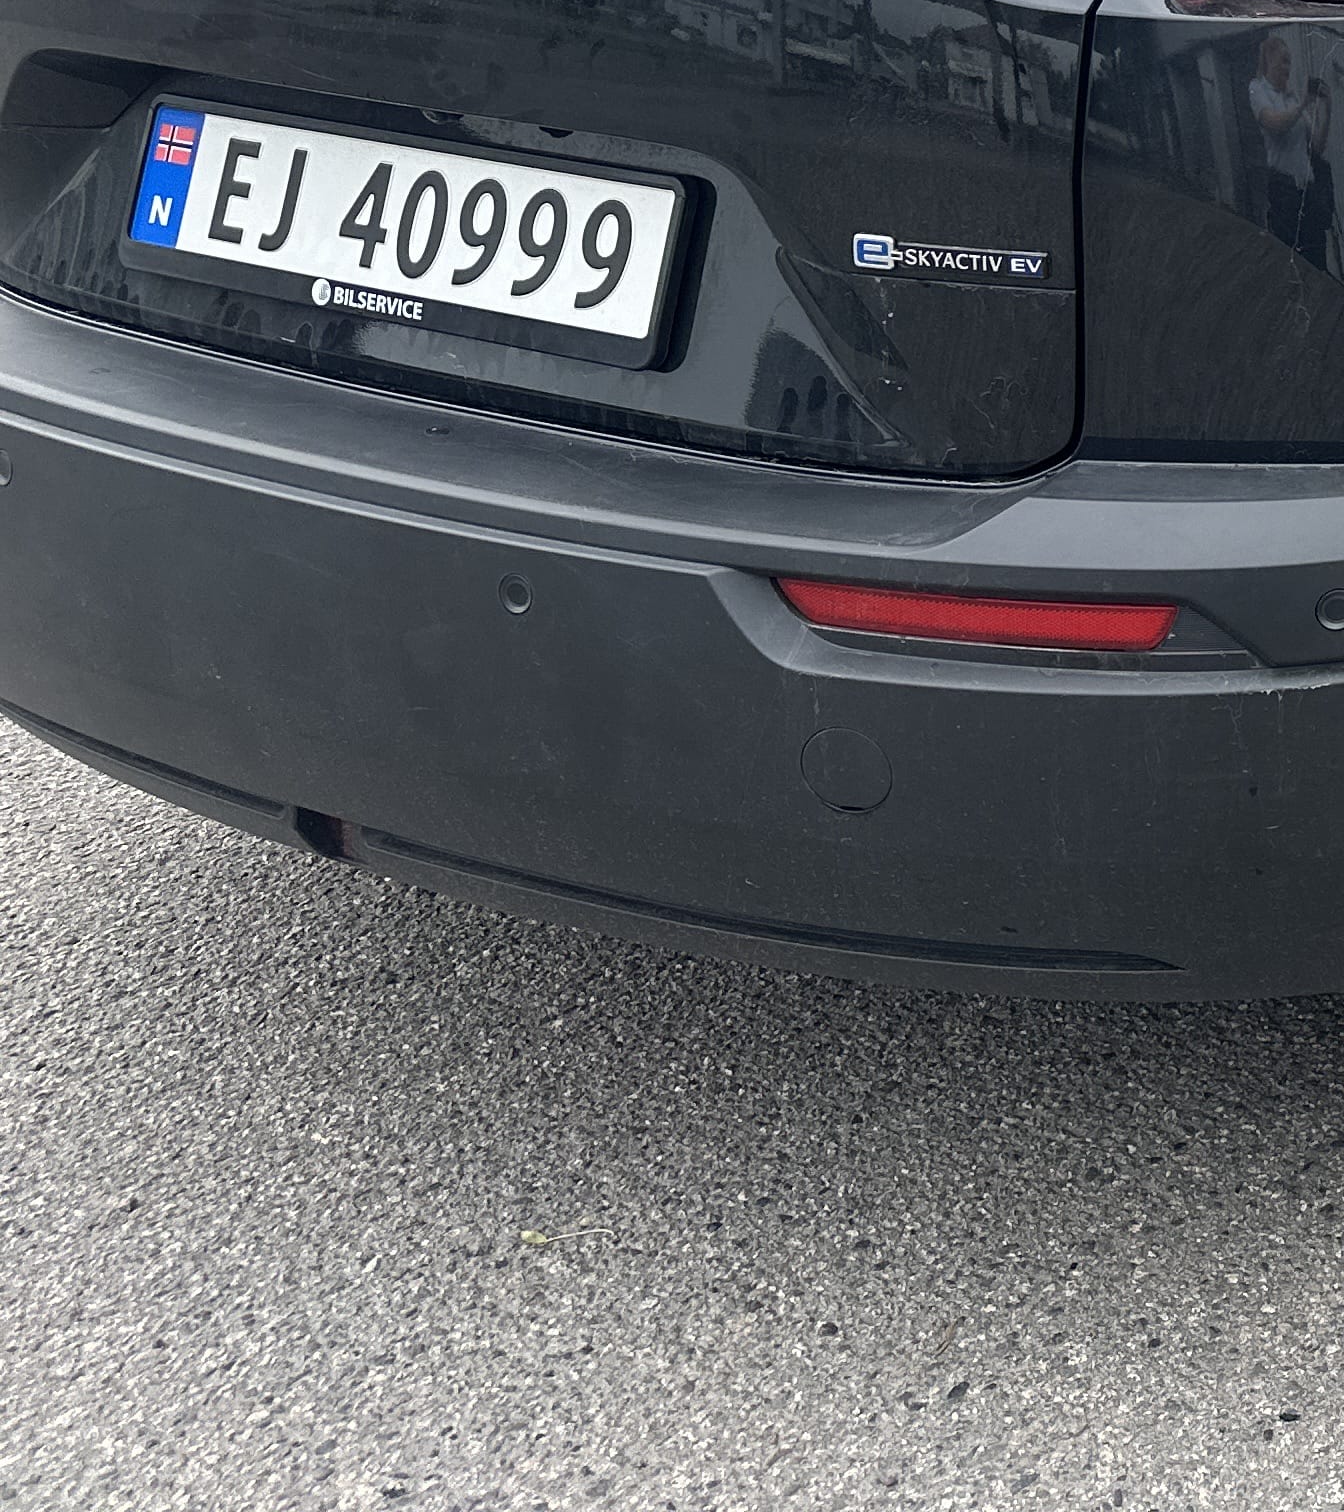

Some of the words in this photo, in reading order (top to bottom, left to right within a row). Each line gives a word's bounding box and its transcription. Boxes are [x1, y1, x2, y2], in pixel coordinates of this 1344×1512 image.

[148, 195, 173, 226] N
[207, 137, 308, 252] EJ
[339, 161, 634, 309] 40999
[1010, 258, 1042, 273] EV
[333, 286, 424, 321] BILSERVICE
